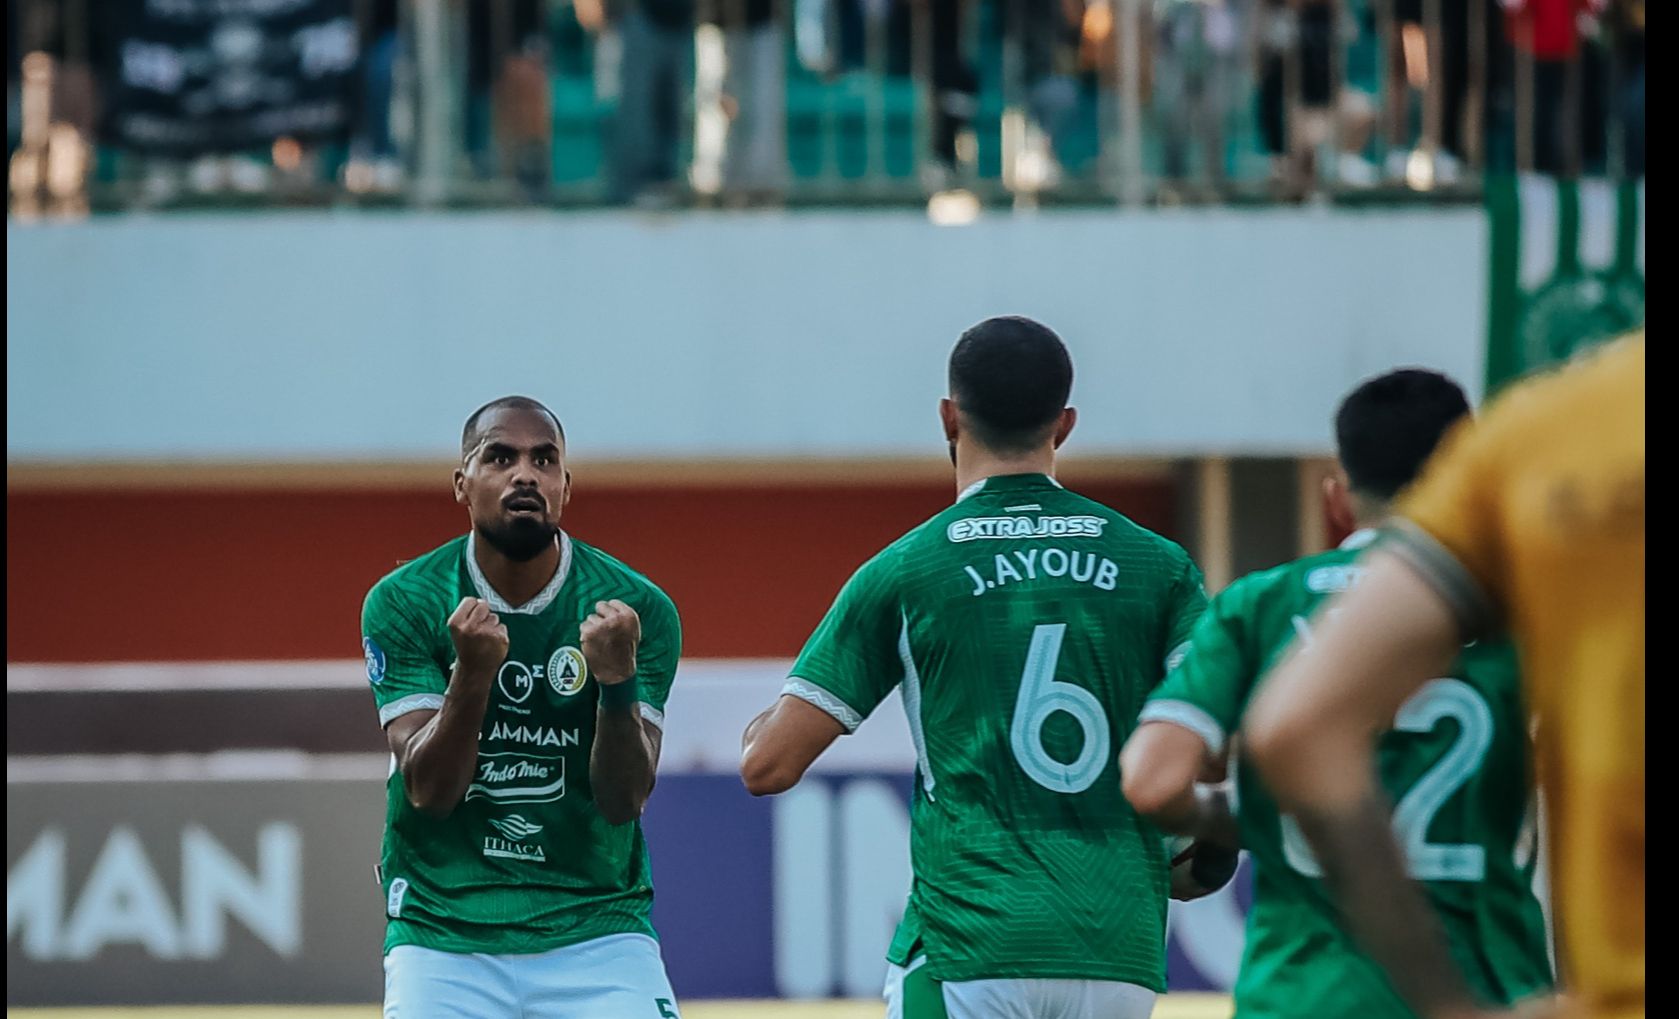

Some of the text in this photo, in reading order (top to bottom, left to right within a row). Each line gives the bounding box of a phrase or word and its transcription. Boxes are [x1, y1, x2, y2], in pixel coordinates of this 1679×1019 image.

[964, 548, 1119, 596] J.AYOUB
[1010, 623, 1111, 794] 6
[488, 721, 579, 747] AMMAN
[484, 836, 544, 856] ITHACA
